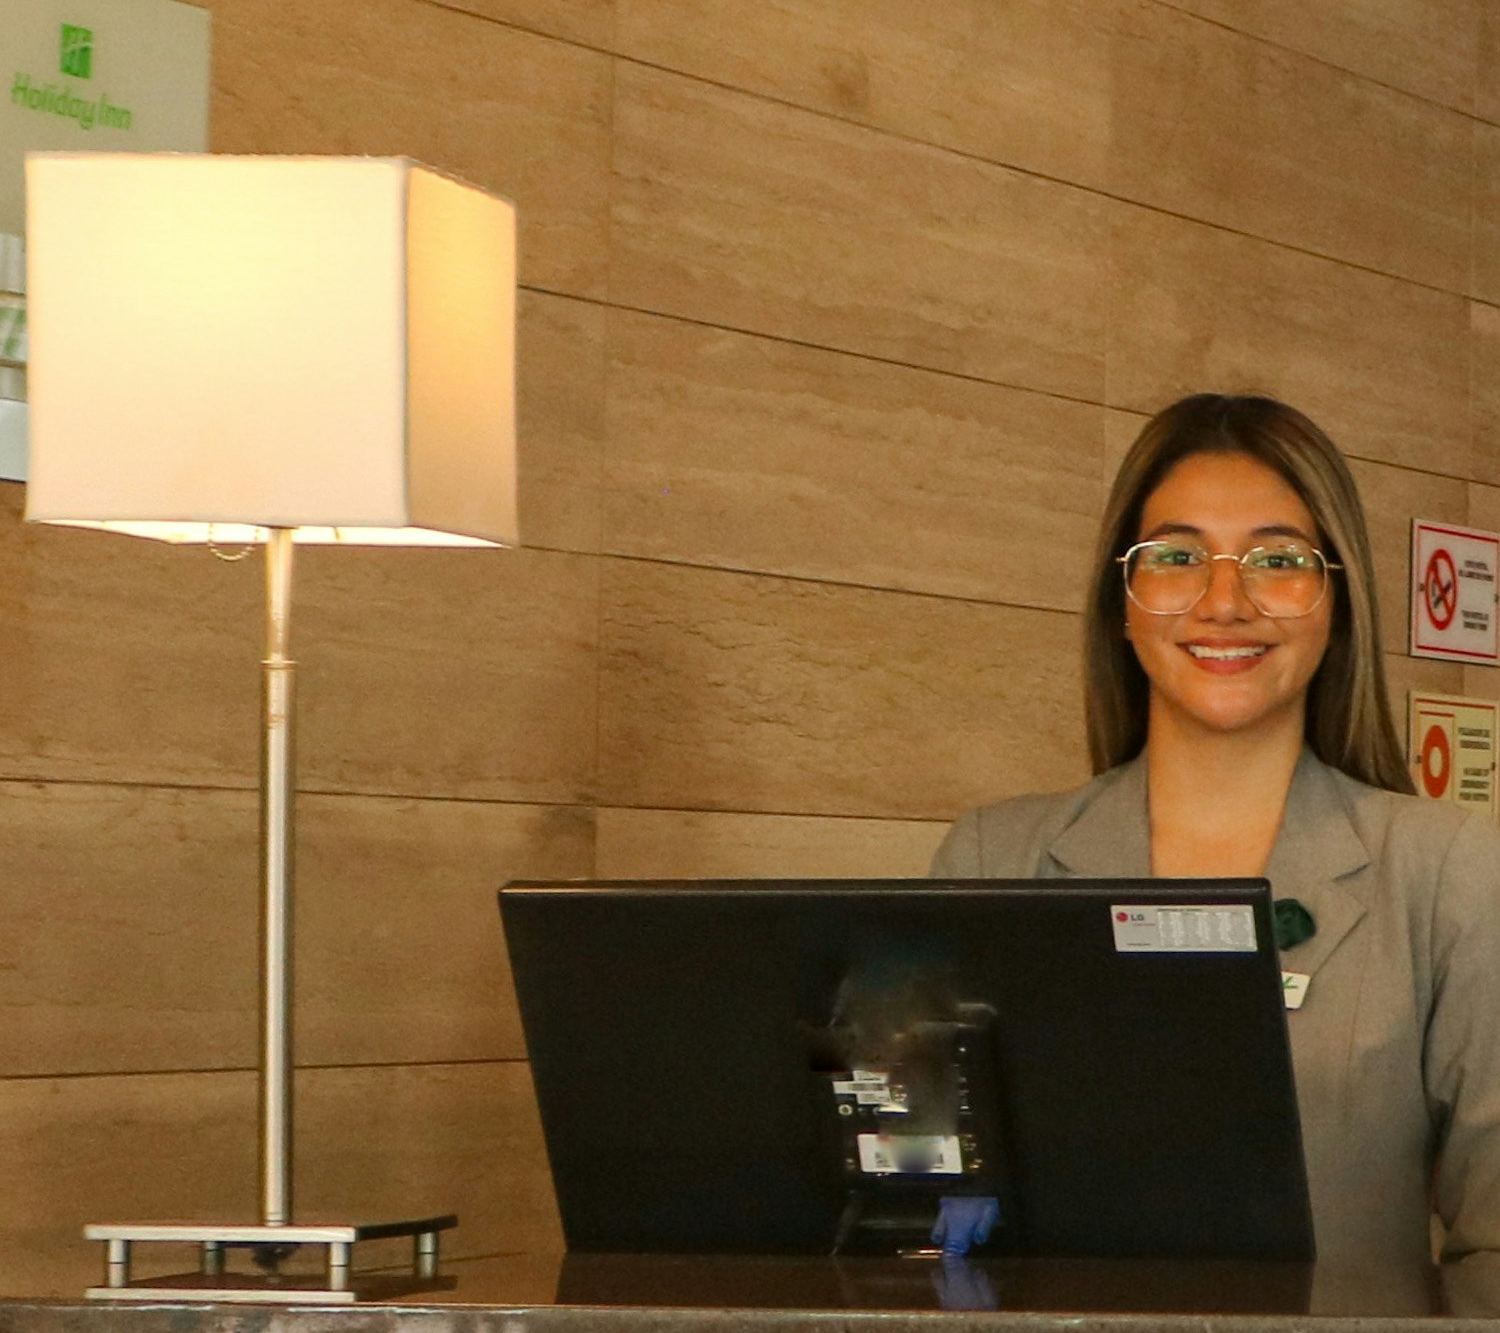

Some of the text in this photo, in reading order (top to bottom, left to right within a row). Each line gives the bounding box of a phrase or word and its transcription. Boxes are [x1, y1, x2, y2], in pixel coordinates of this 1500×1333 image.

[11, 72, 132, 130] Holiday Inn
[1131, 913, 1145, 921] LG
